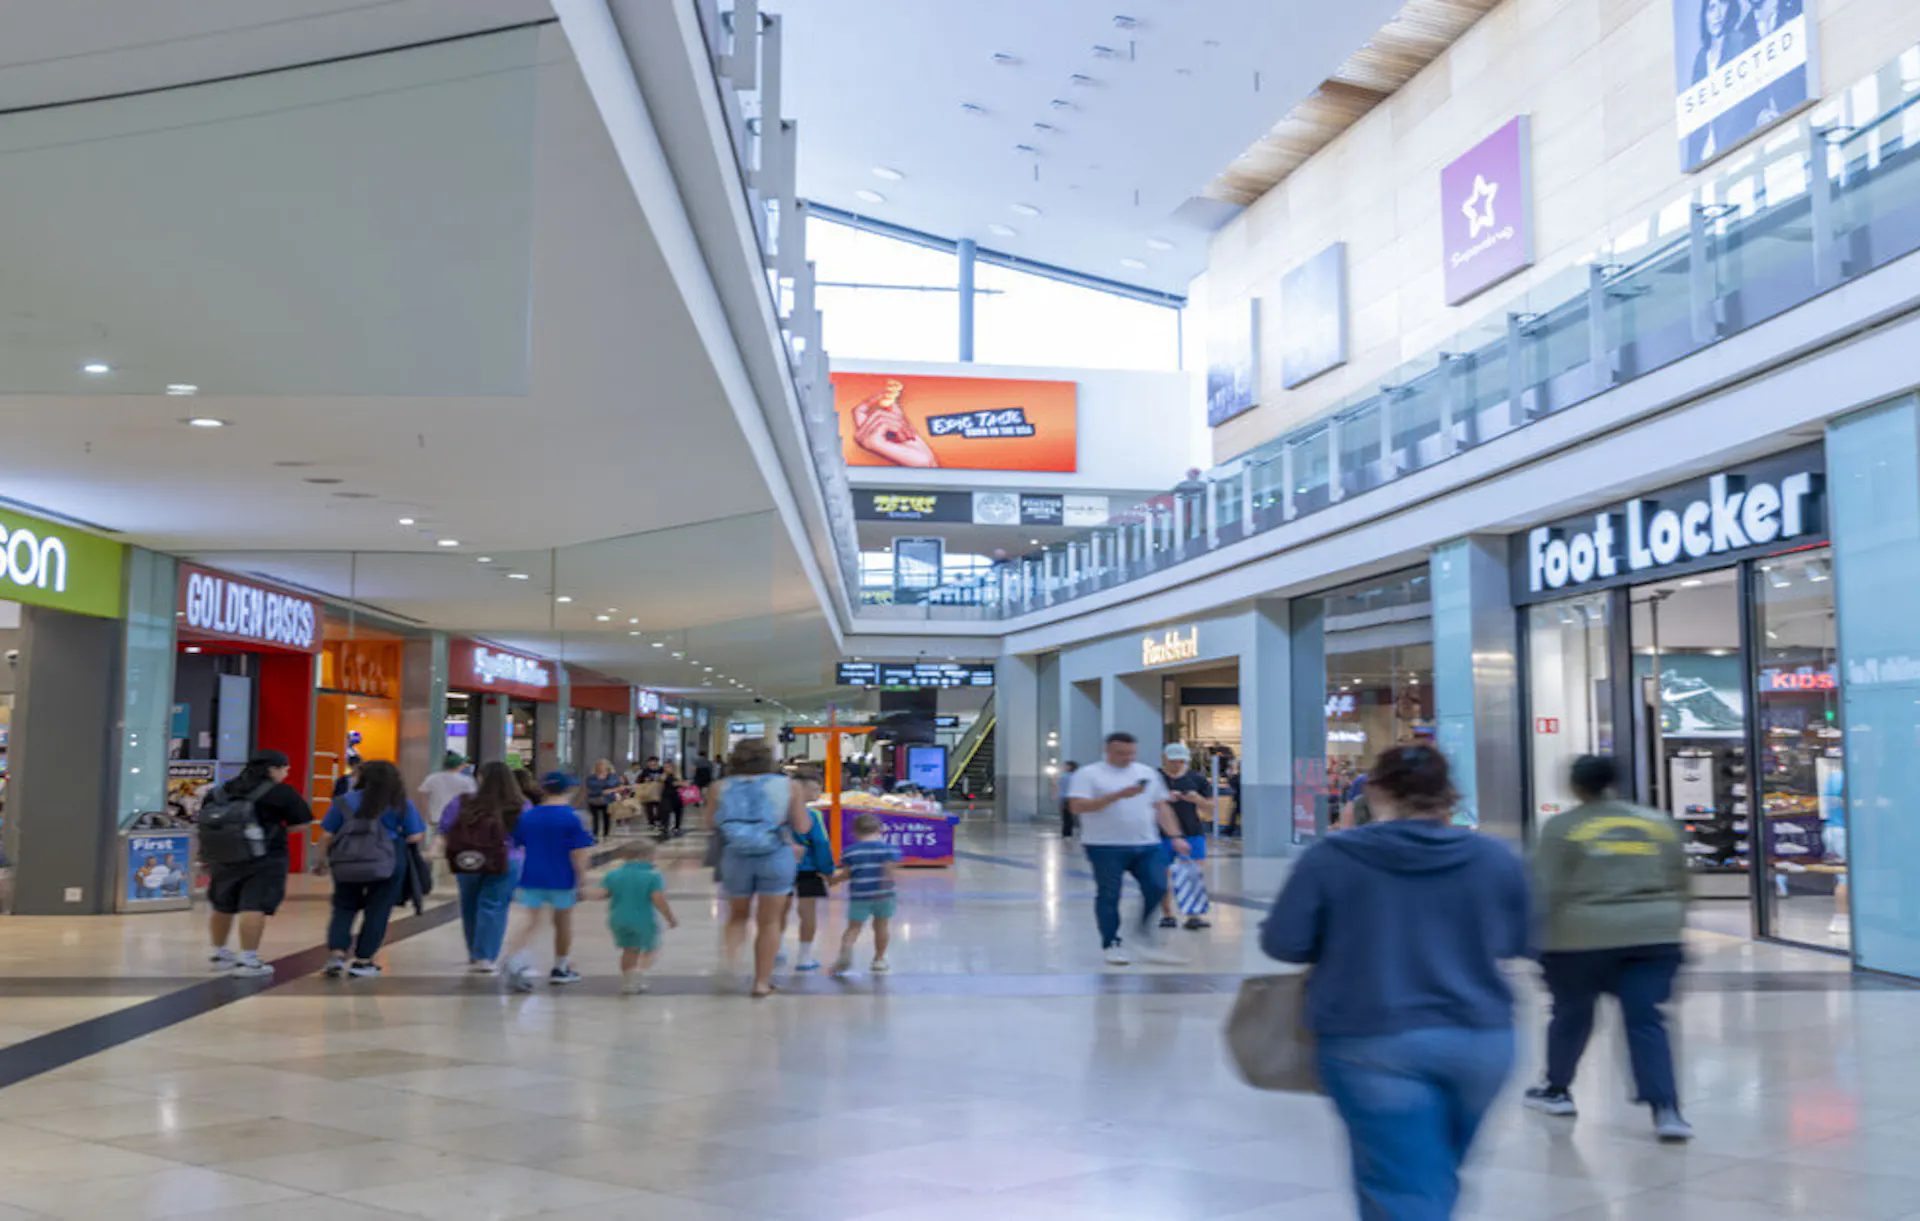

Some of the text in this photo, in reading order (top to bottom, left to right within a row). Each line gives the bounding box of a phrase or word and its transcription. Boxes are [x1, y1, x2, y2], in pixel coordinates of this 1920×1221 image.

[1685, 32, 1793, 113] SELECTED
[1528, 472, 1811, 593] Foot Locker
[186, 572, 316, 649] GOLDEN DISCS
[1771, 673, 1835, 689] KIDS
[132, 838, 175, 851] First
